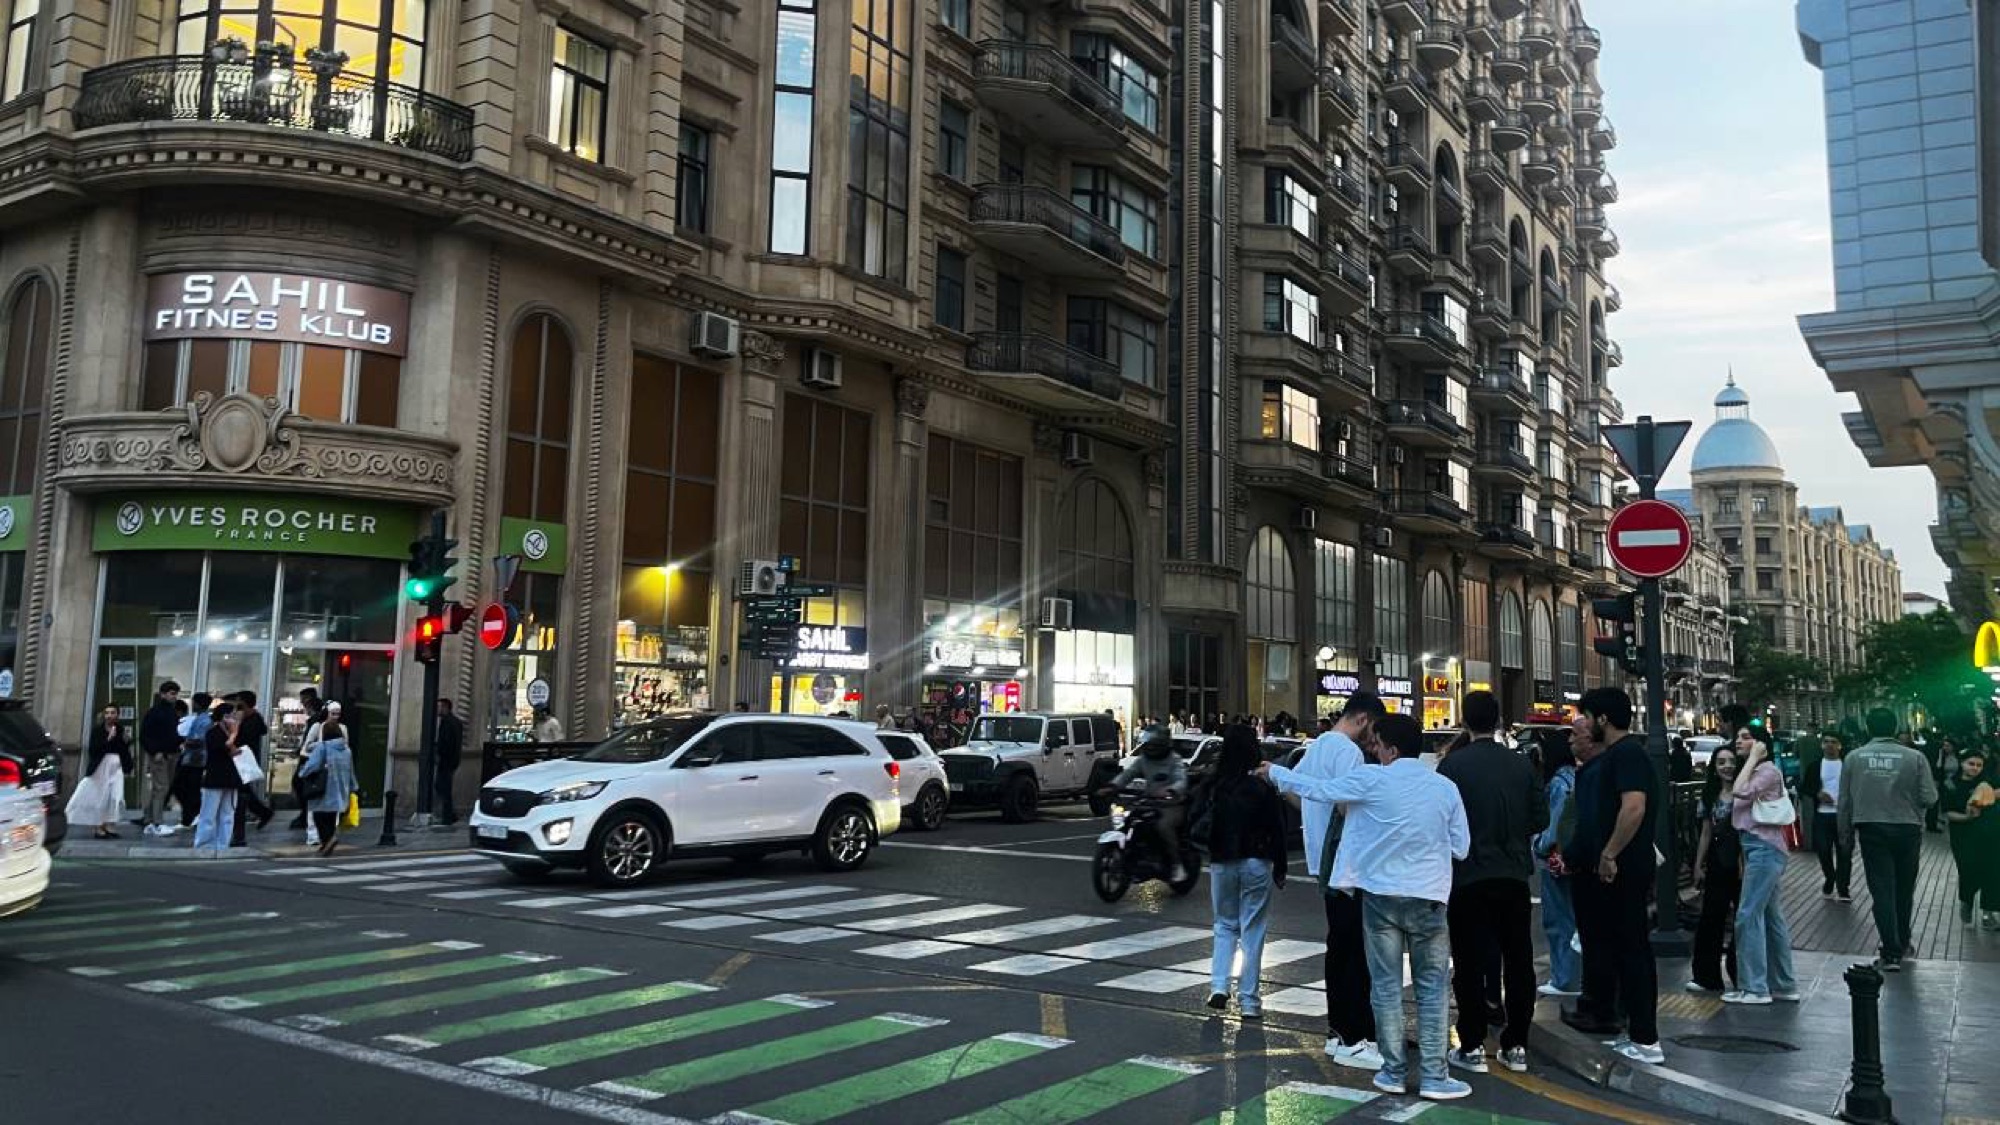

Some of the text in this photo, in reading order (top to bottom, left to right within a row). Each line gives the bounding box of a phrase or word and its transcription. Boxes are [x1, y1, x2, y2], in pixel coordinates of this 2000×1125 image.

[182, 274, 366, 317] SAHIL
[156, 308, 391, 345] FITNES KLUB
[151, 507, 377, 534] YVES ROCHER
[215, 529, 306, 542] FRANCE
